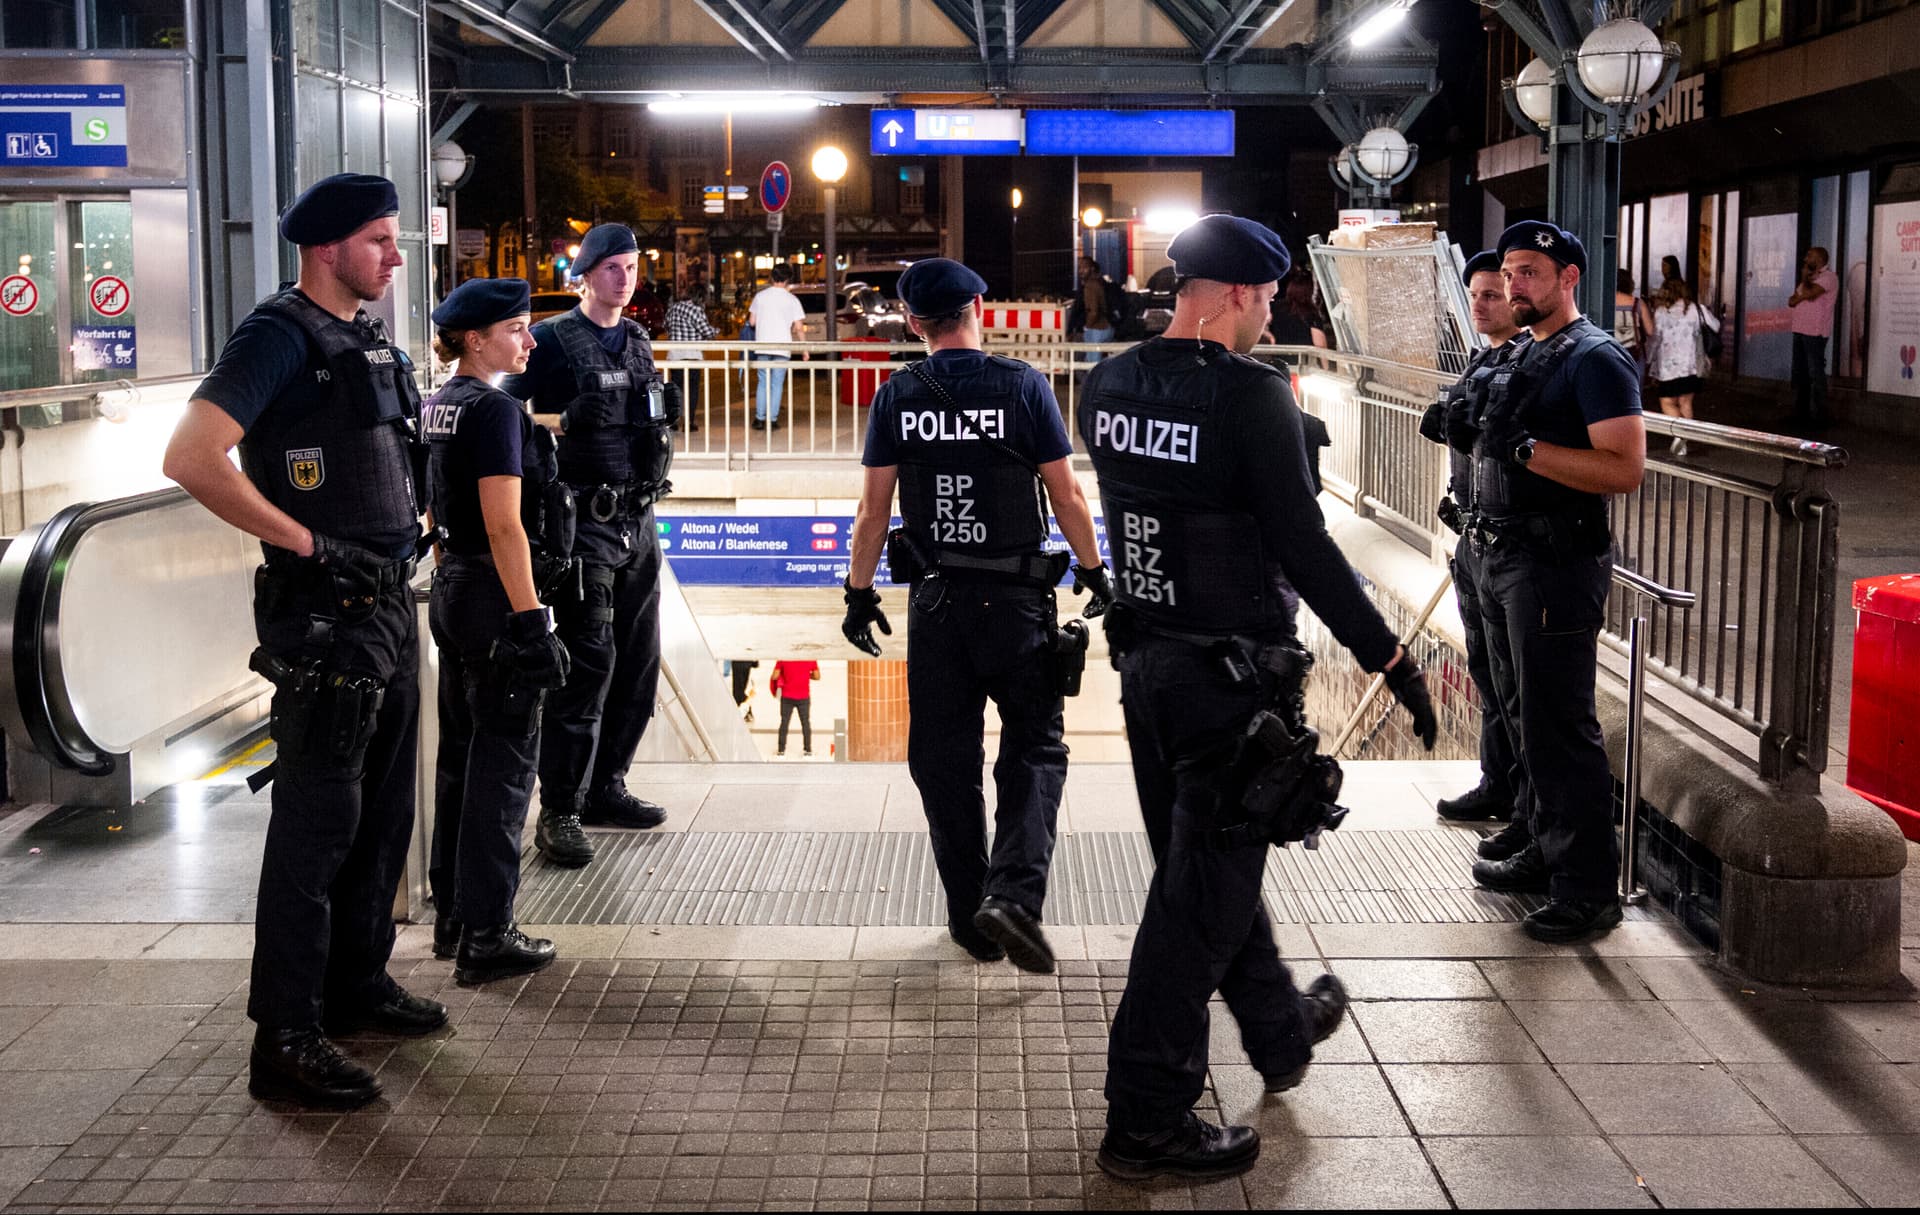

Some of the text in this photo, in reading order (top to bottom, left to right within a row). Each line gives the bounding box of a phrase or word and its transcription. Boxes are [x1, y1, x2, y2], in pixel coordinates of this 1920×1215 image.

[1655, 73, 1705, 131] SUITE
[87, 119, 107, 141] S
[77, 329, 132, 339] Vorfahrt für
[364, 349, 395, 364] POLIZEI
[421, 404, 462, 434] OLIZEI
[901, 409, 1005, 441] POLIZEI
[1095, 410, 1198, 464] POLIZEI
[290, 451, 319, 461] POLIZEI
[936, 474, 973, 496] BP
[936, 498, 976, 520] RZ
[681, 522, 716, 534] Altona
[725, 523, 759, 534] Wedel
[930, 521, 987, 543] 1250
[1123, 512, 1160, 543] BP
[681, 539, 716, 550] Altona
[726, 539, 788, 550] Blankenese
[786, 562, 816, 573] Zugang
[833, 562, 847, 571] mit
[1124, 541, 1164, 576] RZ
[1121, 569, 1176, 606] 1251
